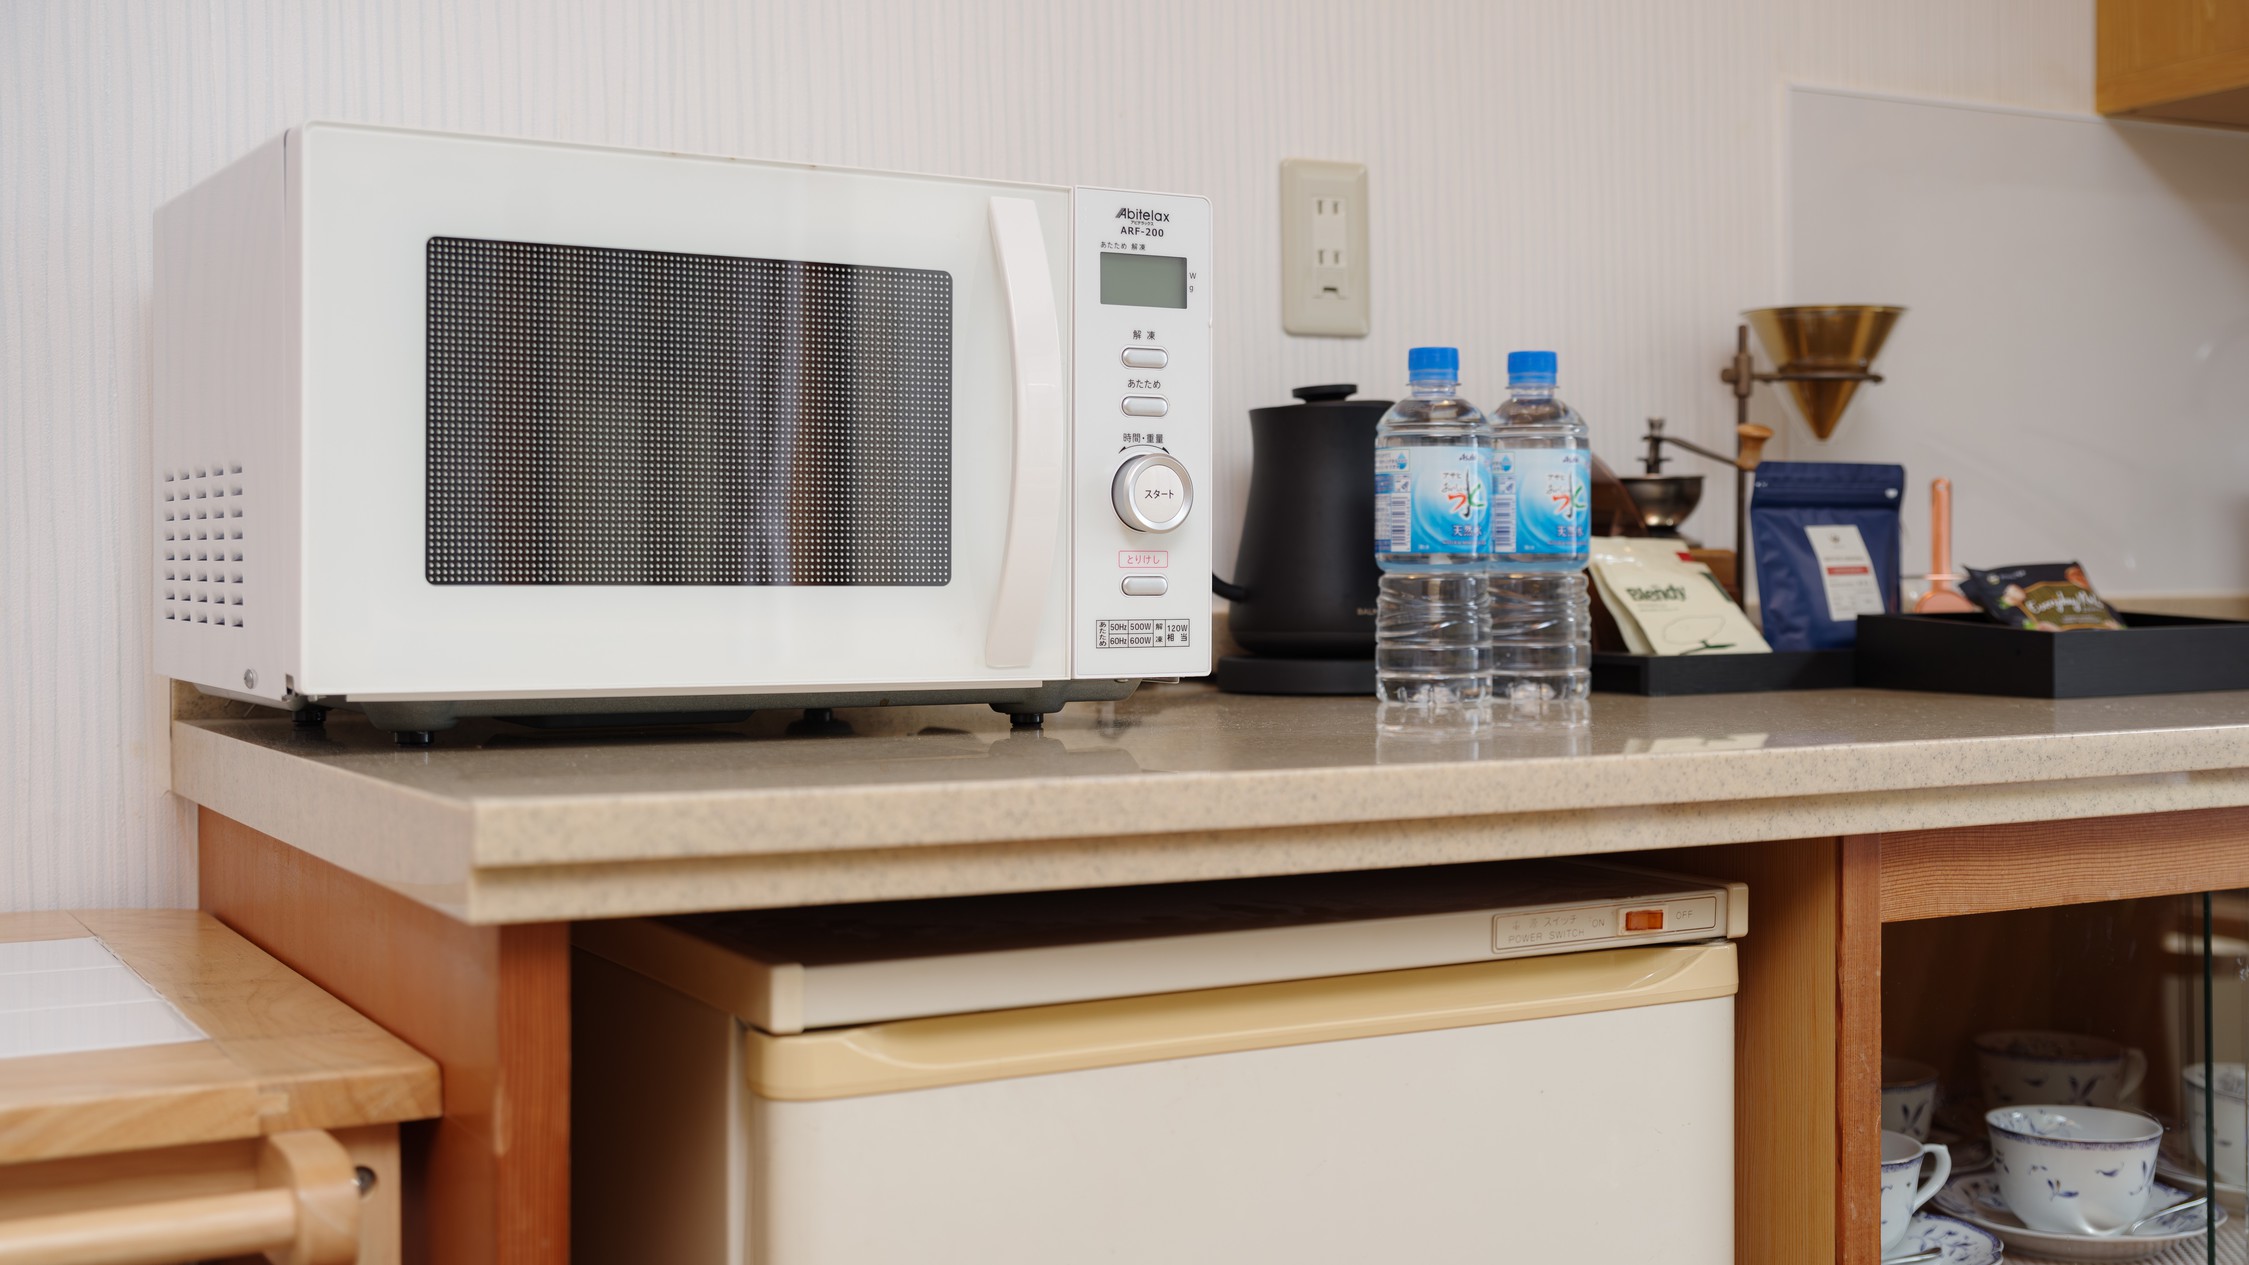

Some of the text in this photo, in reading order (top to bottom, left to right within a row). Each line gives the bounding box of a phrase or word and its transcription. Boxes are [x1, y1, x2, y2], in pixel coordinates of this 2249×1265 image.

[1115, 207, 1170, 223] Abitelax
[1120, 226, 1164, 237] ARF-200
[1100, 241, 1146, 251] あたため 解凍
[1127, 379, 1161, 389] あたため
[1122, 433, 1164, 443] 時間・重量
[1144, 489, 1174, 499] スタート
[1127, 555, 1160, 565] とりけし
[1625, 583, 1686, 602] Blendy
[1110, 623, 1127, 631] 50Hz
[1110, 637, 1127, 645] 60Hz
[1167, 633, 1188, 642] 相当
[1676, 910, 1693, 920] OFF
[1591, 919, 1605, 928] ON
[1508, 928, 1585, 944] POWER SWITCH
